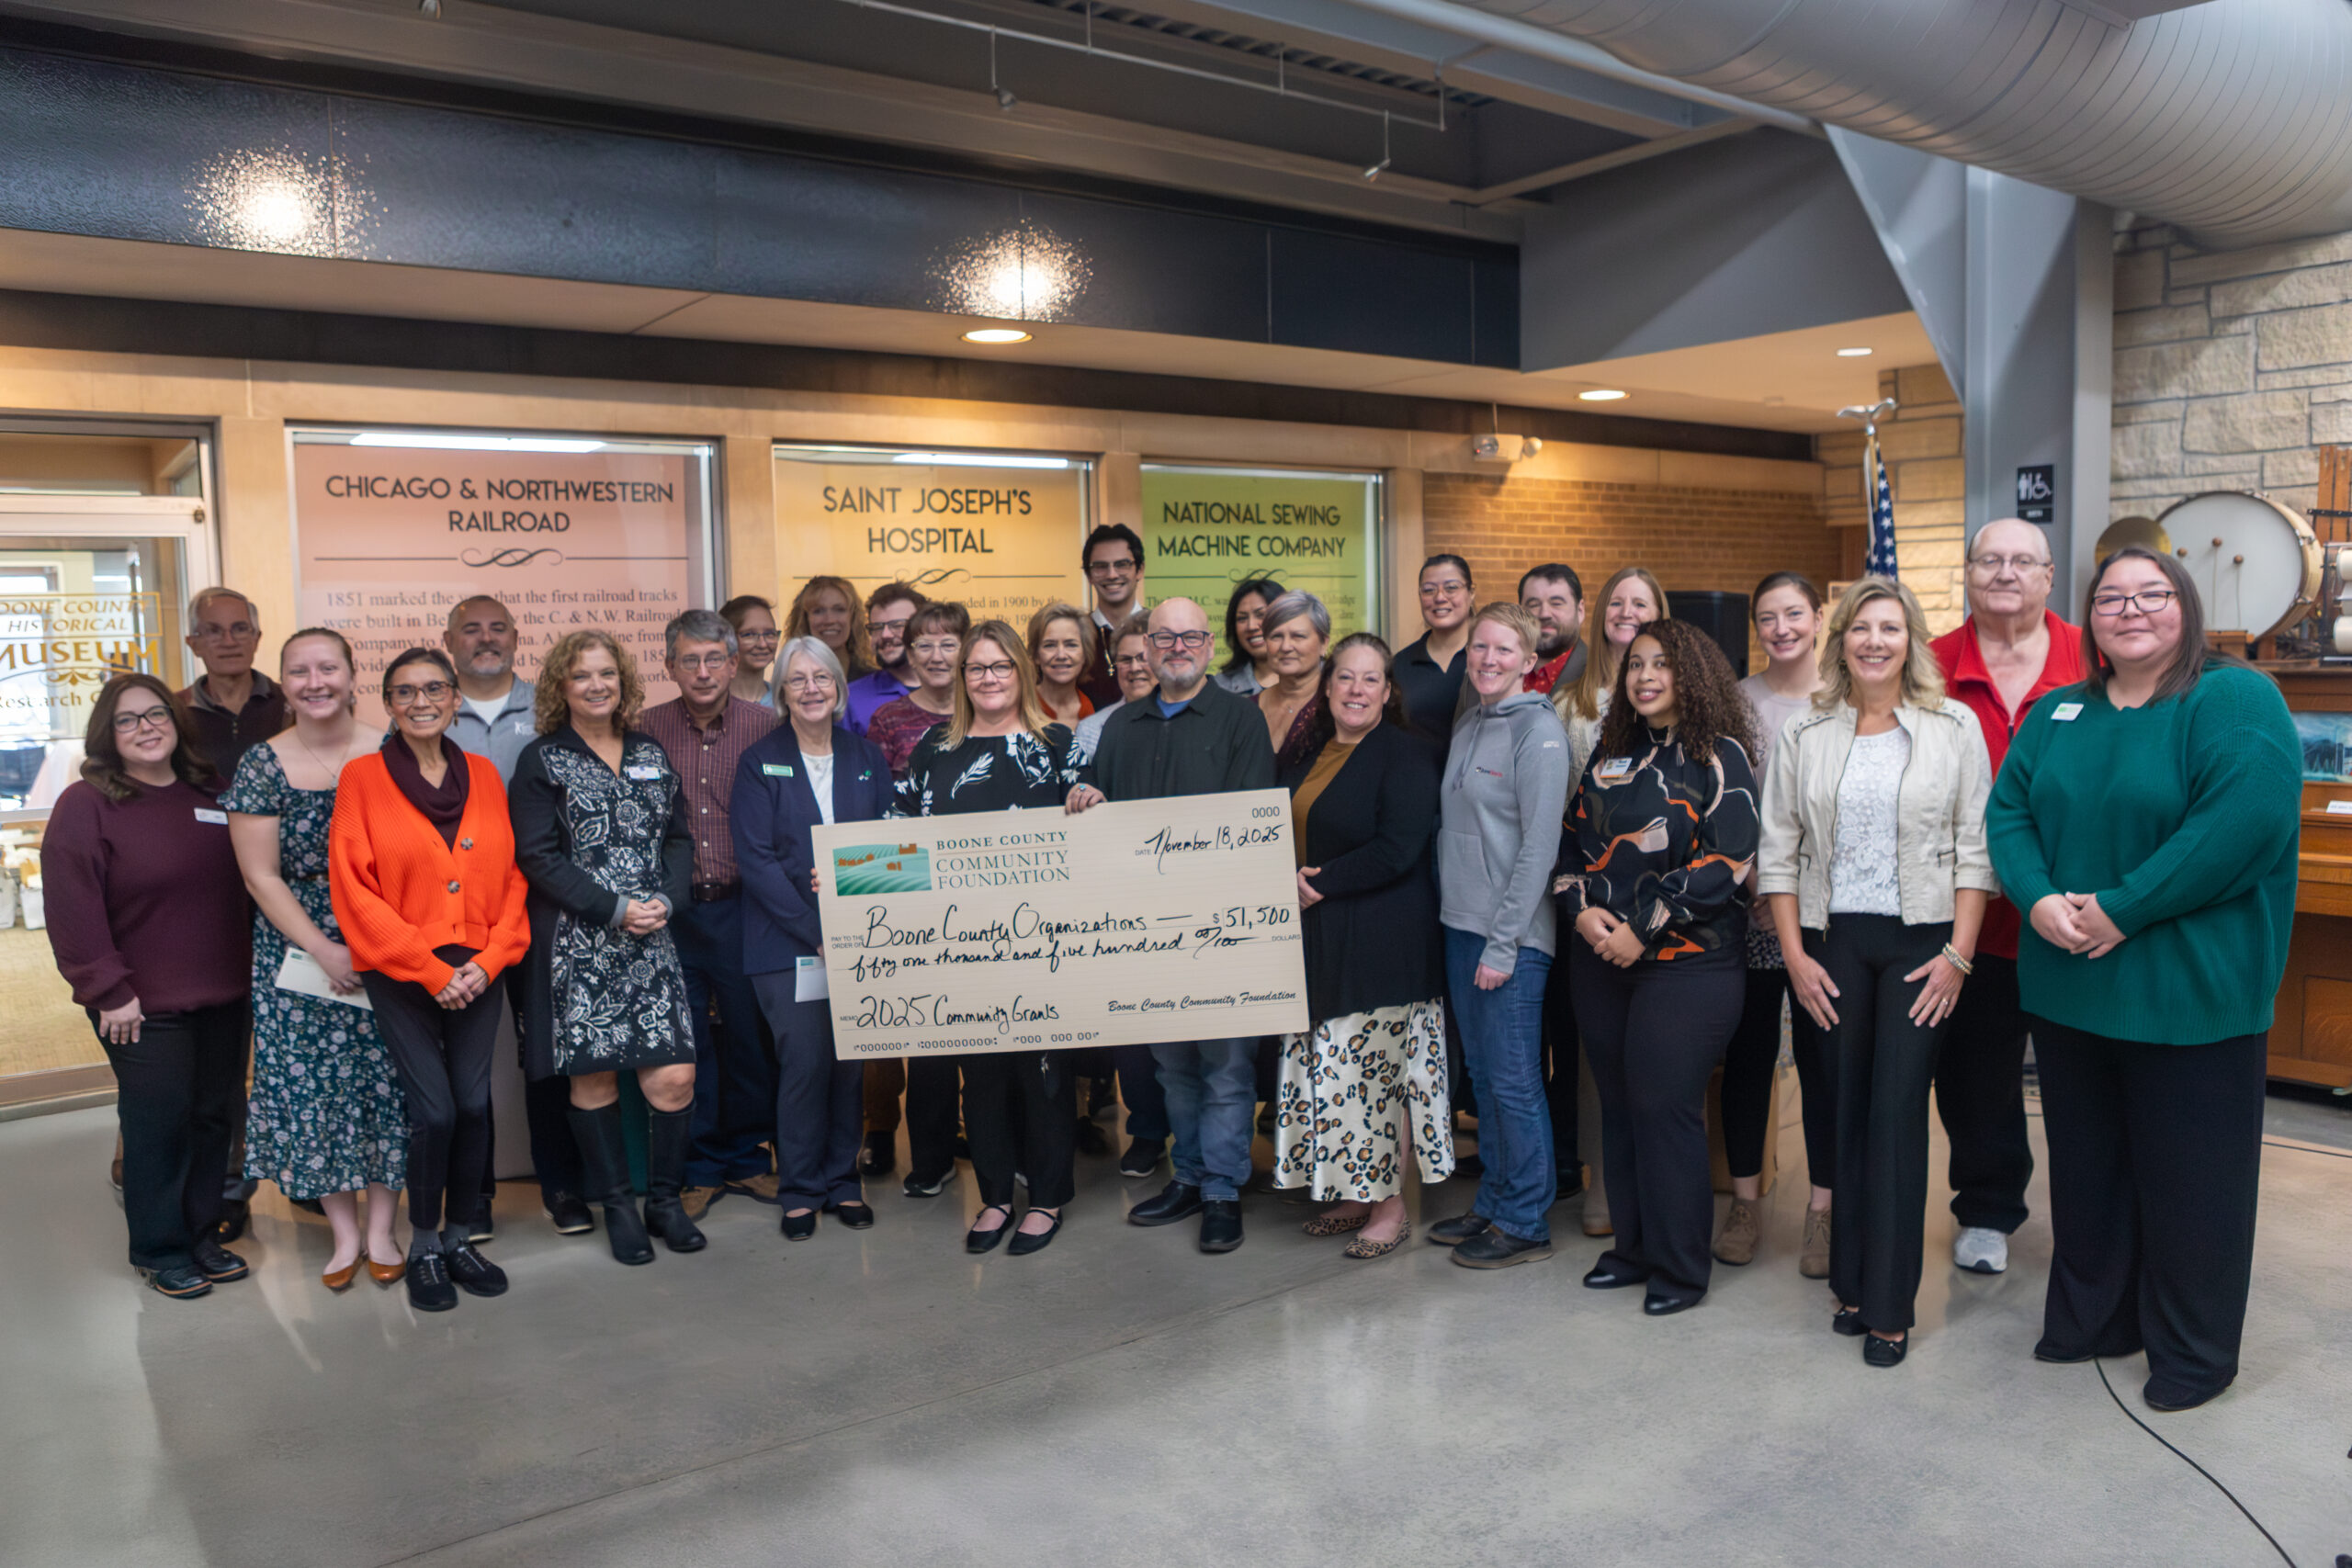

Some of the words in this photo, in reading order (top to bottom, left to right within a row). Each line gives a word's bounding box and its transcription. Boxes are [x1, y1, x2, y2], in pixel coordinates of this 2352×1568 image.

[325, 475, 451, 499] CHICAGO
[460, 478, 479, 500] &
[487, 479, 674, 502] NORTHWESTERN
[823, 486, 902, 513] SAINT
[912, 488, 1032, 514] JOSEPH'S
[448, 511, 571, 533] RAILROAD
[1162, 502, 1267, 525] NATIONAL
[1272, 503, 1340, 526] SEWING
[867, 527, 994, 553] HOSPITAL
[1158, 535, 1251, 557] MACHINE
[1257, 536, 1346, 558] COMPANY
[63, 599, 151, 615] COUNTY
[326, 592, 364, 606] 1851
[369, 592, 427, 606] marked
[432, 591, 456, 605] the
[494, 590, 522, 604] that
[526, 590, 547, 604] the
[551, 589, 579, 603] first
[583, 589, 635, 603] railroad
[639, 588, 678, 602] tracks
[8, 618, 129, 632] HISTORICAL
[322, 618, 361, 629] were
[367, 615, 401, 628] built
[407, 615, 421, 627] in
[524, 611, 545, 625] the
[548, 610, 565, 624] C.
[569, 612, 582, 624] &
[626, 608, 681, 623] Railroad
[420, 637, 435, 649] to
[643, 649, 665, 662] 185
[1251, 807, 1281, 818] 0000
[936, 837, 993, 851] BOONE
[1000, 830, 1069, 846] COUNTY
[1144, 826, 1213, 875] November
[1237, 823, 1286, 847] 2025
[935, 850, 1069, 874] COMMUNITY
[1135, 848, 1152, 857] DATE
[938, 866, 1071, 890] FOUNDATION
[1225, 906, 1291, 930] 51,500
[861, 905, 940, 949] Boone
[943, 904, 1013, 957] County
[1013, 902, 1148, 942] Organizations
[1271, 933, 1302, 942] DOLLARS
[848, 954, 897, 983] fifty
[1012, 947, 1043, 961] and
[1046, 940, 1087, 974] five
[1091, 931, 1188, 958] hundred
[1108, 999, 1137, 1012] Boone
[1140, 998, 1176, 1012] County
[1180, 992, 1237, 1010] Community
[1239, 989, 1297, 1005] Foundation
[855, 994, 933, 1029] 2025
[933, 994, 1010, 1035] Community
[1012, 995, 1060, 1022] Grants
